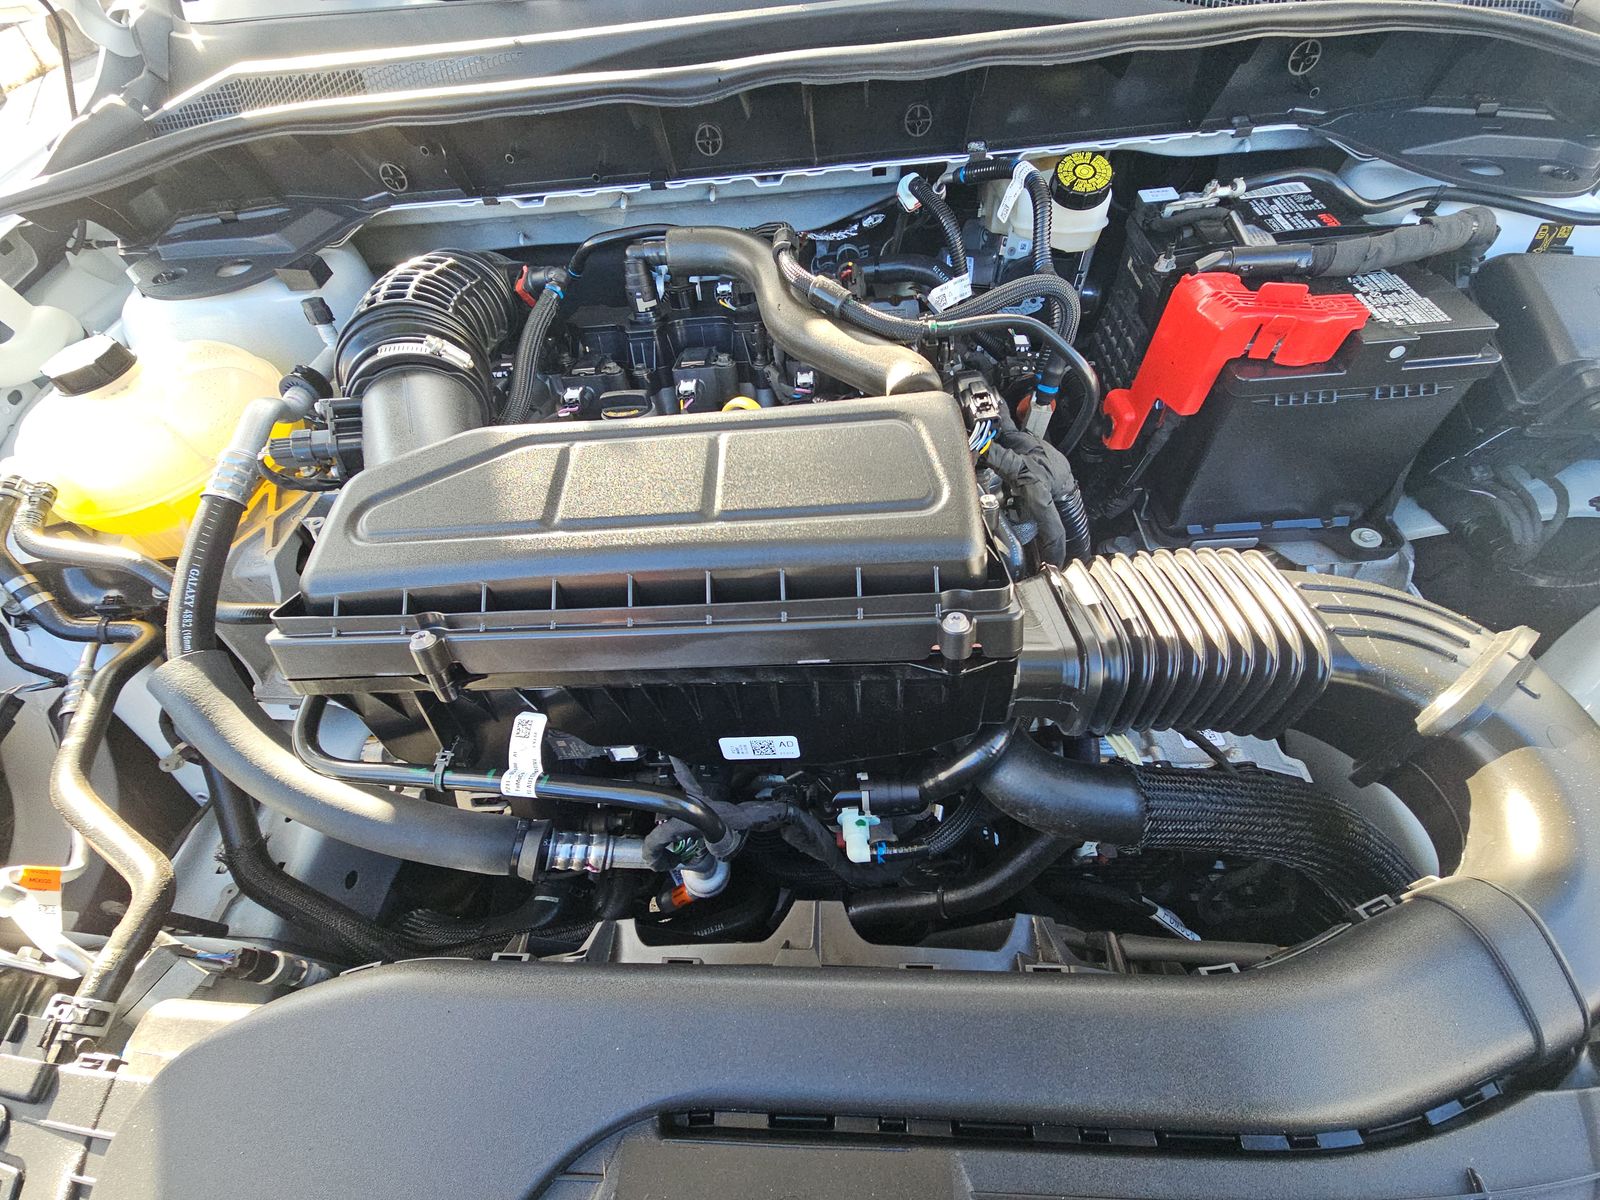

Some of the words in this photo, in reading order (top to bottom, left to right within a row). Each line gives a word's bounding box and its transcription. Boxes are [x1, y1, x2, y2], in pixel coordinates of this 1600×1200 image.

[184, 568, 200, 608] GALAXY
[181, 609, 193, 628] 4882
[181, 629, 193, 654] (16mm)
